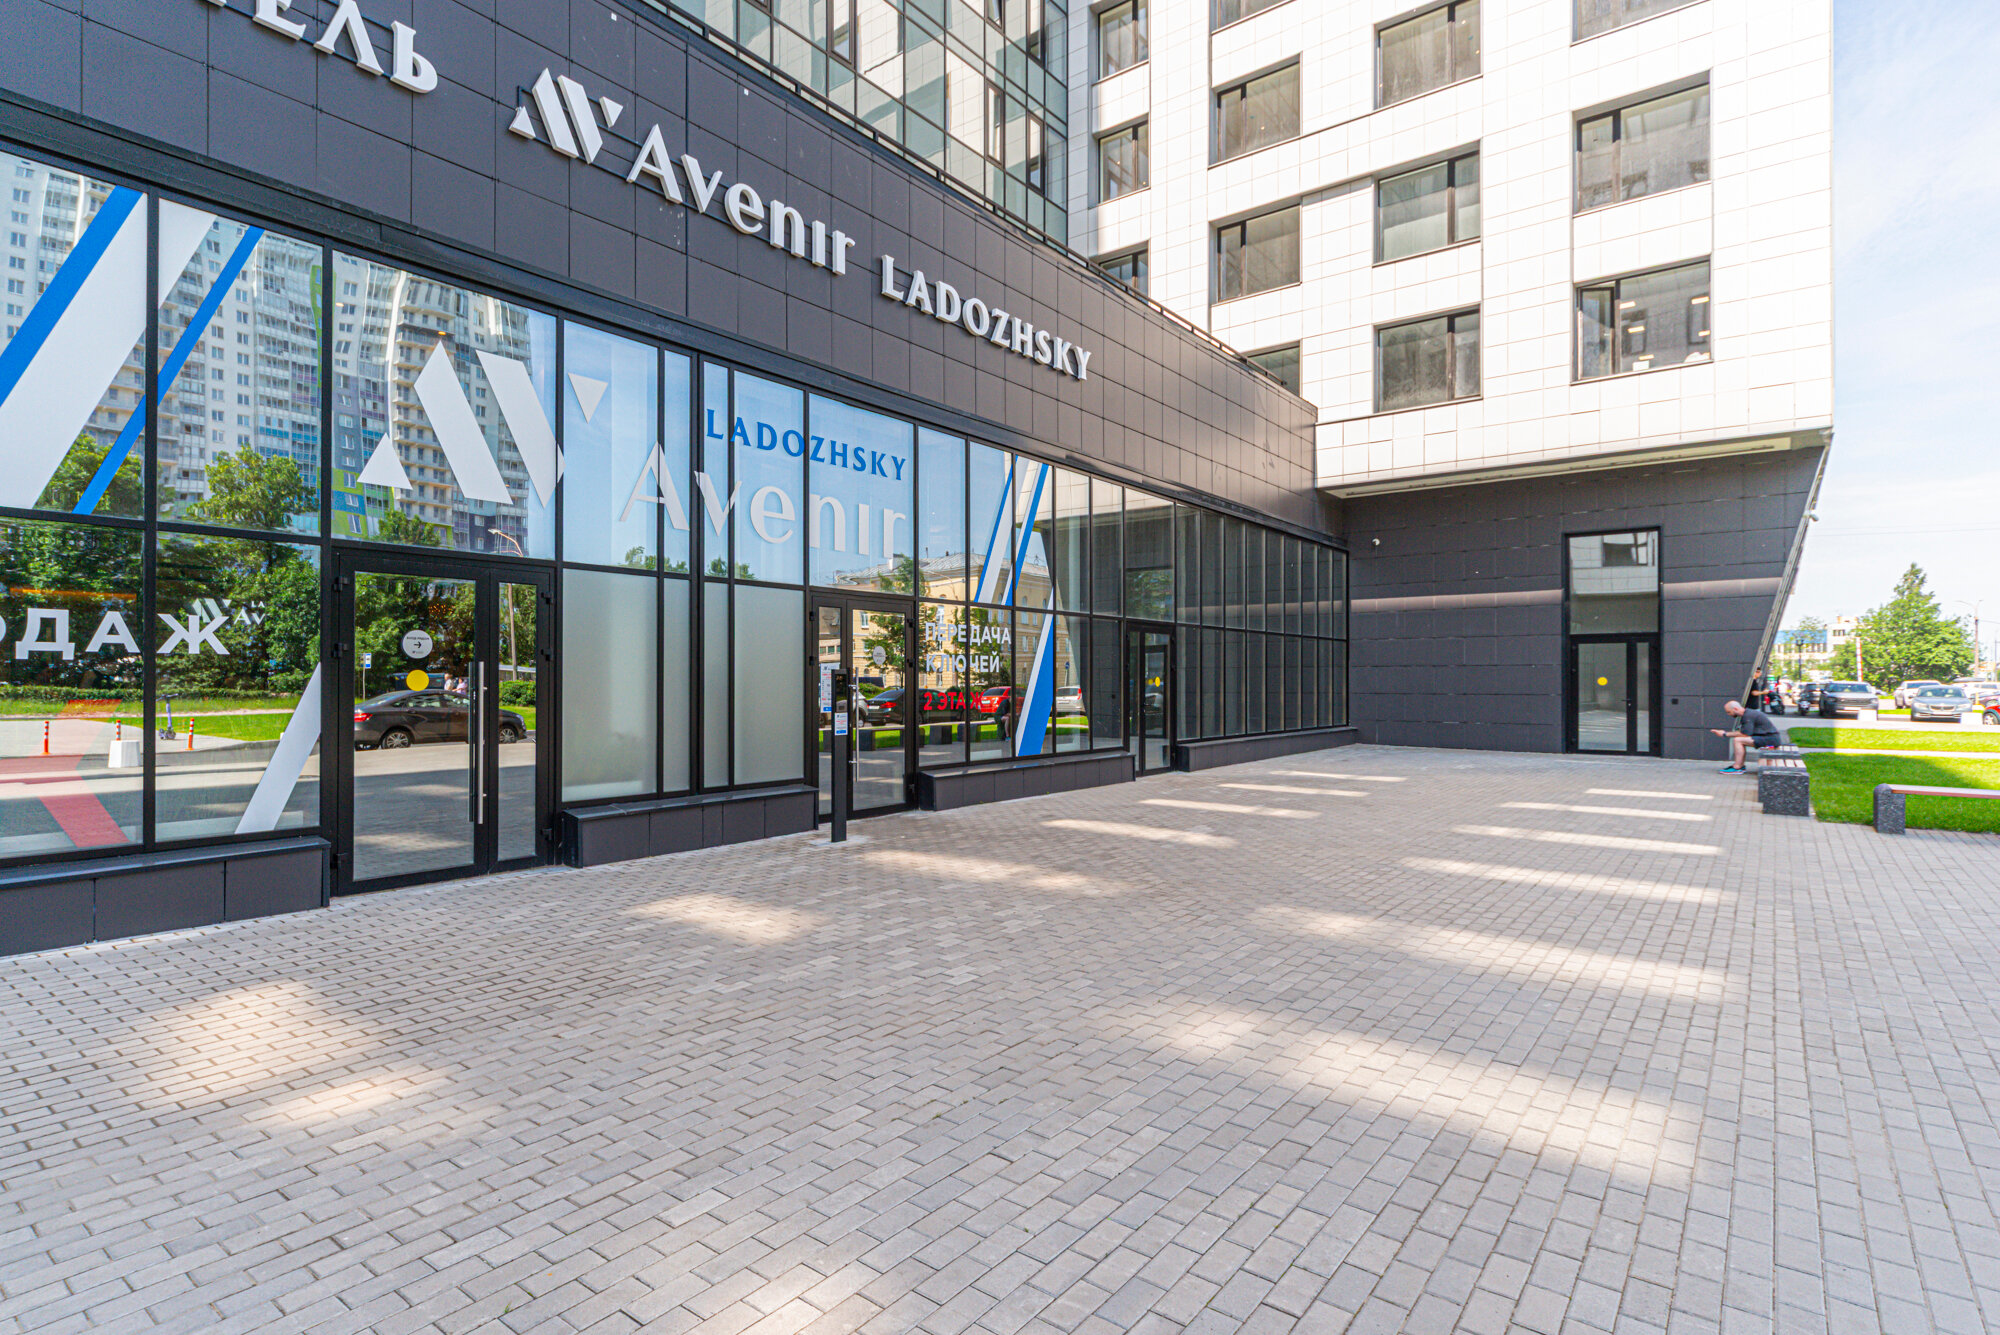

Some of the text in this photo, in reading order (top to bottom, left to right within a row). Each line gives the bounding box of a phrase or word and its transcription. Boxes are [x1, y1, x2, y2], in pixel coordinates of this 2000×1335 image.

[626, 124, 1092, 381] Avenir LADOZHSKY
[706, 408, 907, 481] LADOZHSKY
[618, 440, 907, 558] Avenir
[0, 607, 231, 661] ДАЖ
[925, 622, 1012, 647] ПЕРЕДАЧА
[926, 650, 1000, 673] КЛЮЧЕЙ
[923, 691, 985, 710] 2 ЭТАЖ
